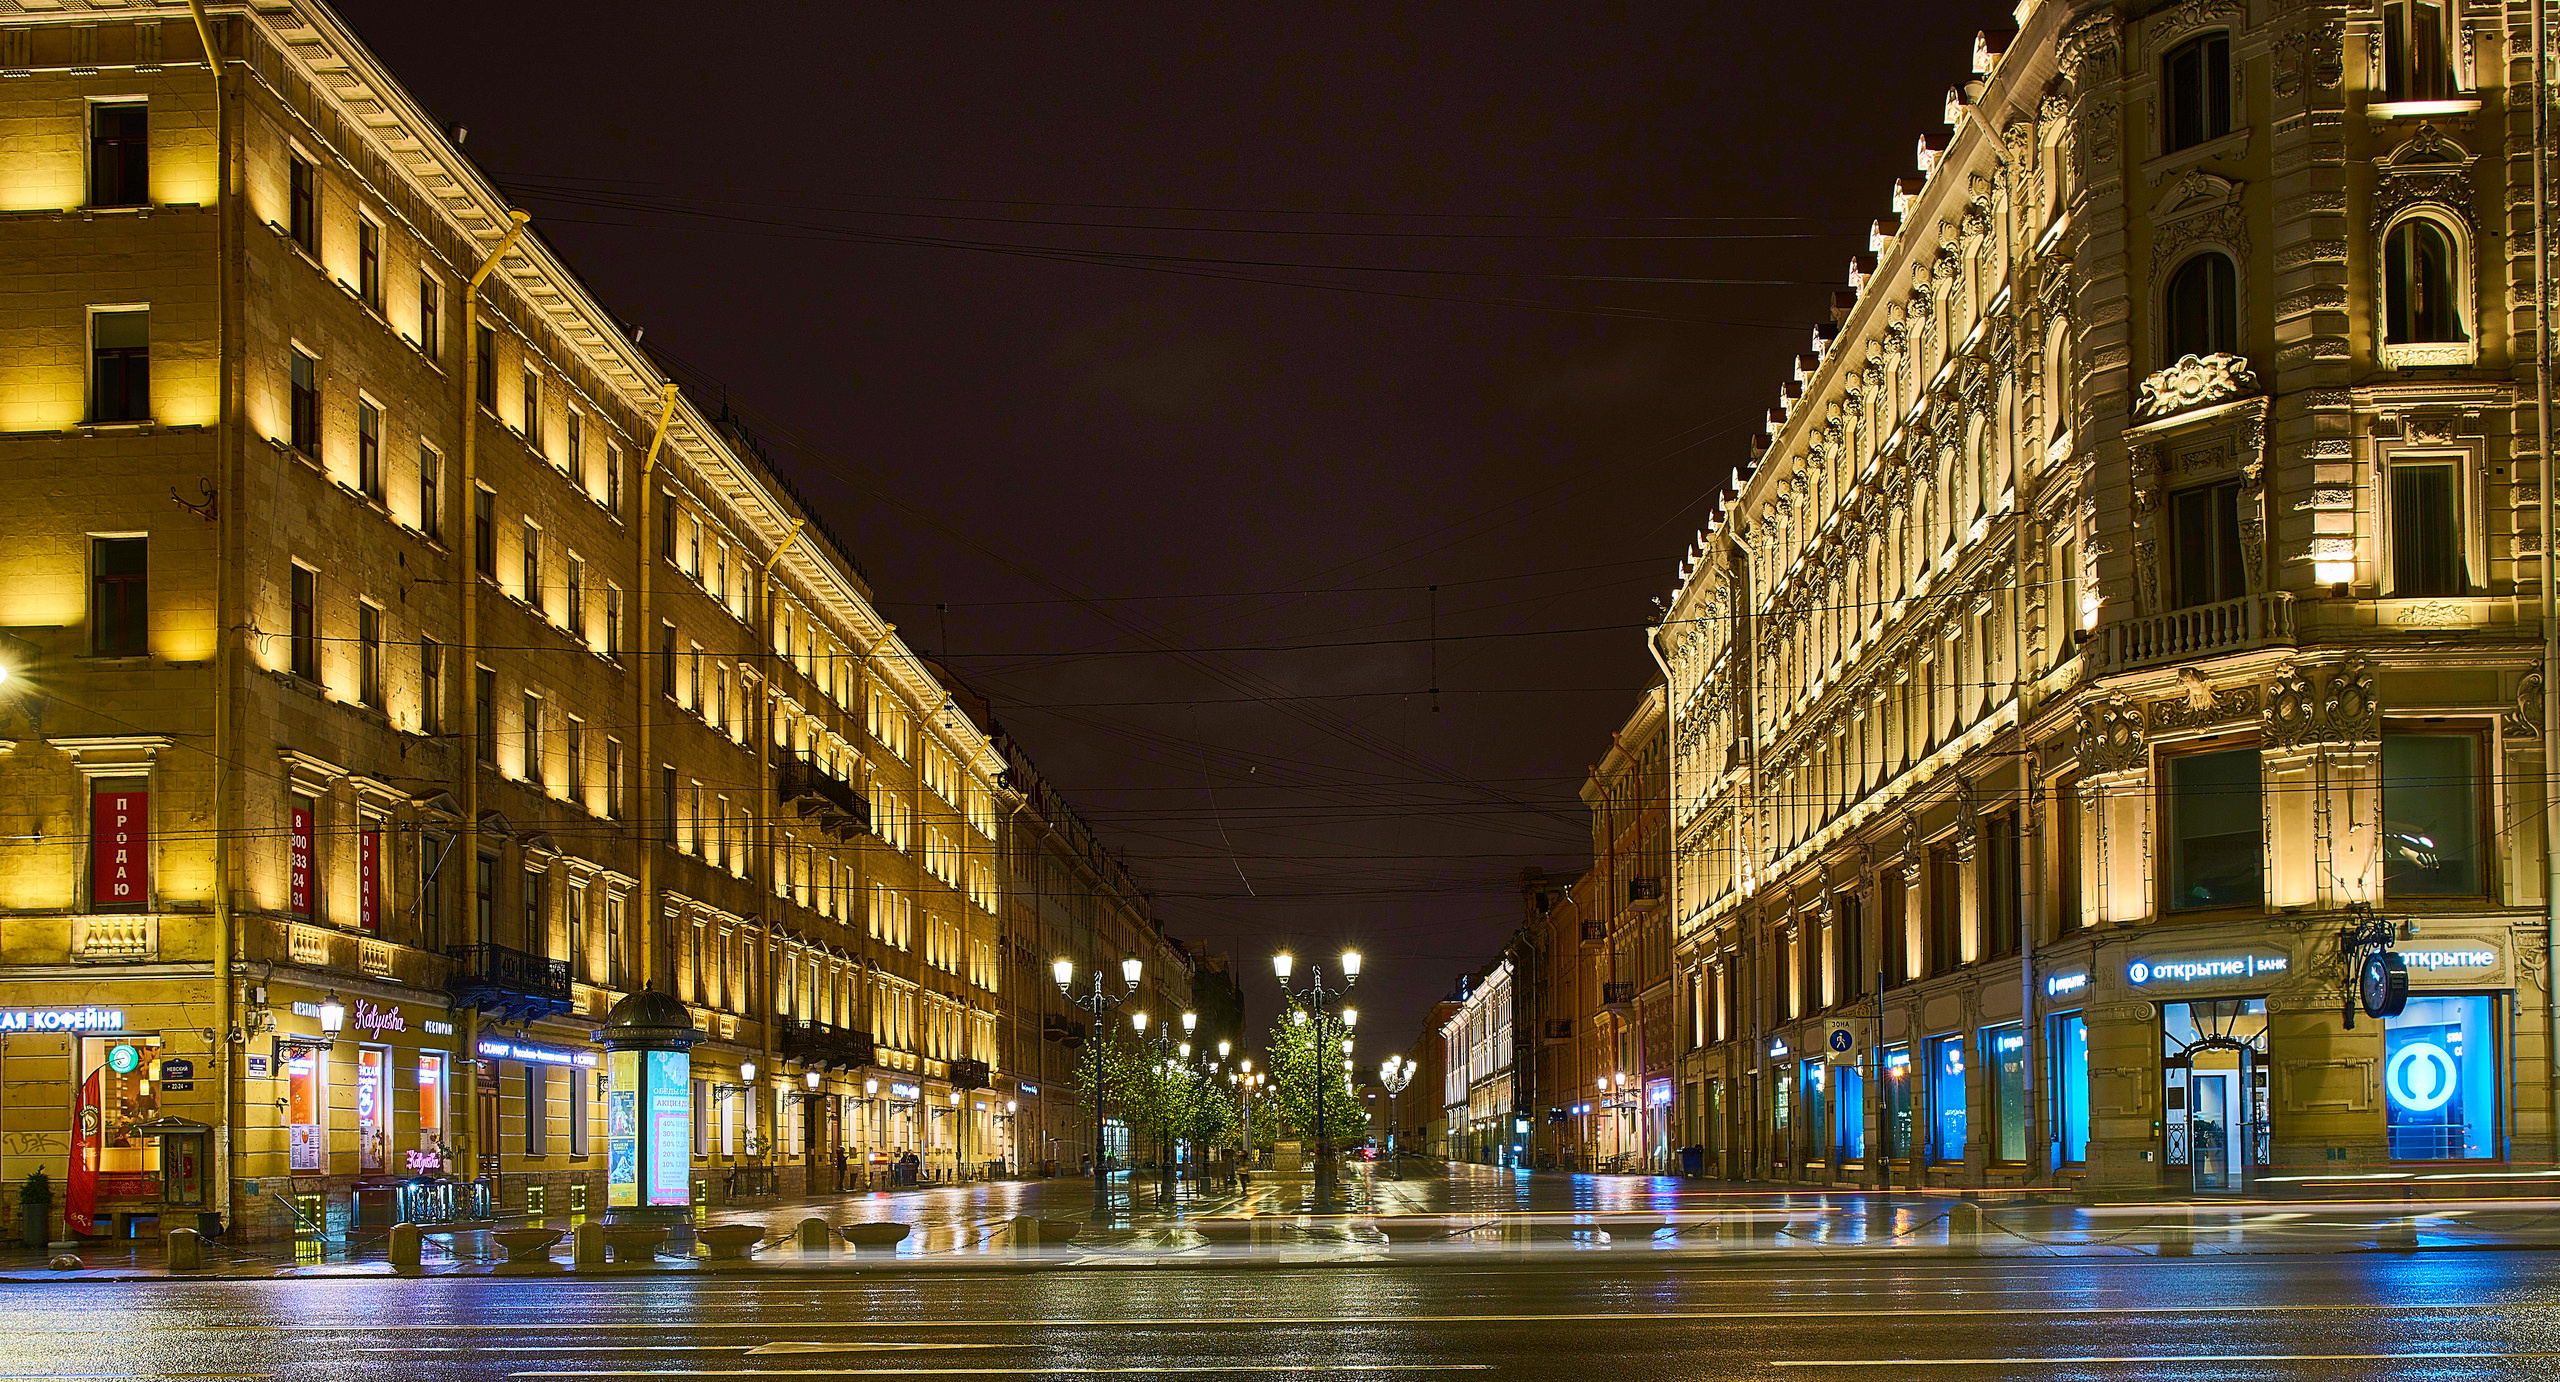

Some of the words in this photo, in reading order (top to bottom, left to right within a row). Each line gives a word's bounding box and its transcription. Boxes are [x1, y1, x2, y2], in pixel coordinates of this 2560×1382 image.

[295, 814, 302, 828] 8
[114, 798, 130, 896] ПРОДАЮ
[293, 872, 305, 887] 24
[292, 892, 304, 908] 31
[2153, 960, 2245, 981] открытие
[2257, 958, 2287, 970] БАНК
[2398, 952, 2495, 970] открытие
[0, 1012, 28, 1029] АЯ
[34, 1007, 123, 1029] КОФЕЙНЯ
[355, 998, 407, 1040] Katyusha
[653, 1087, 679, 1096] ОБЕДЫ
